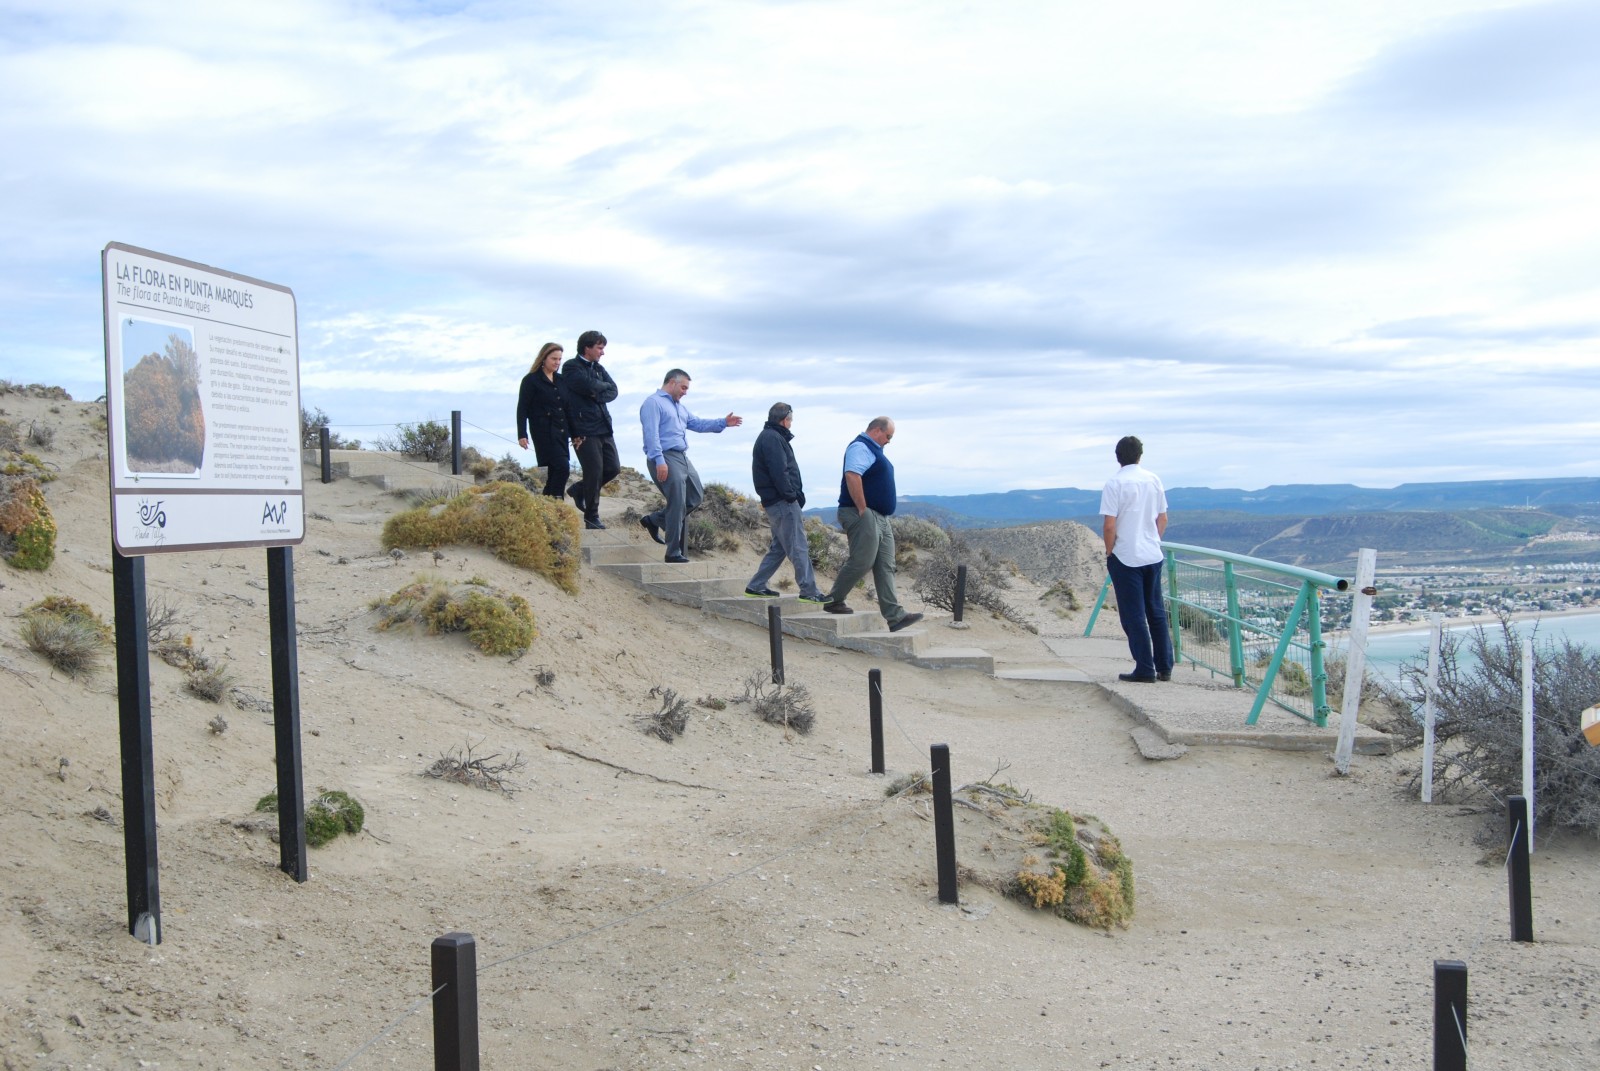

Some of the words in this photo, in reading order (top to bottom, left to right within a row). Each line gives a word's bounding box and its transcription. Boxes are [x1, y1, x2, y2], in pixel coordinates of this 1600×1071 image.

[116, 261, 130, 281] LA
[132, 266, 166, 289] FLORA
[168, 274, 181, 293] EN
[184, 278, 213, 300] PUNTA
[215, 286, 254, 309] MARQUÉS
[117, 282, 131, 297] The
[132, 285, 151, 301] flora
[153, 291, 161, 303] at
[162, 291, 182, 308] Punta
[184, 298, 211, 314] Marqués
